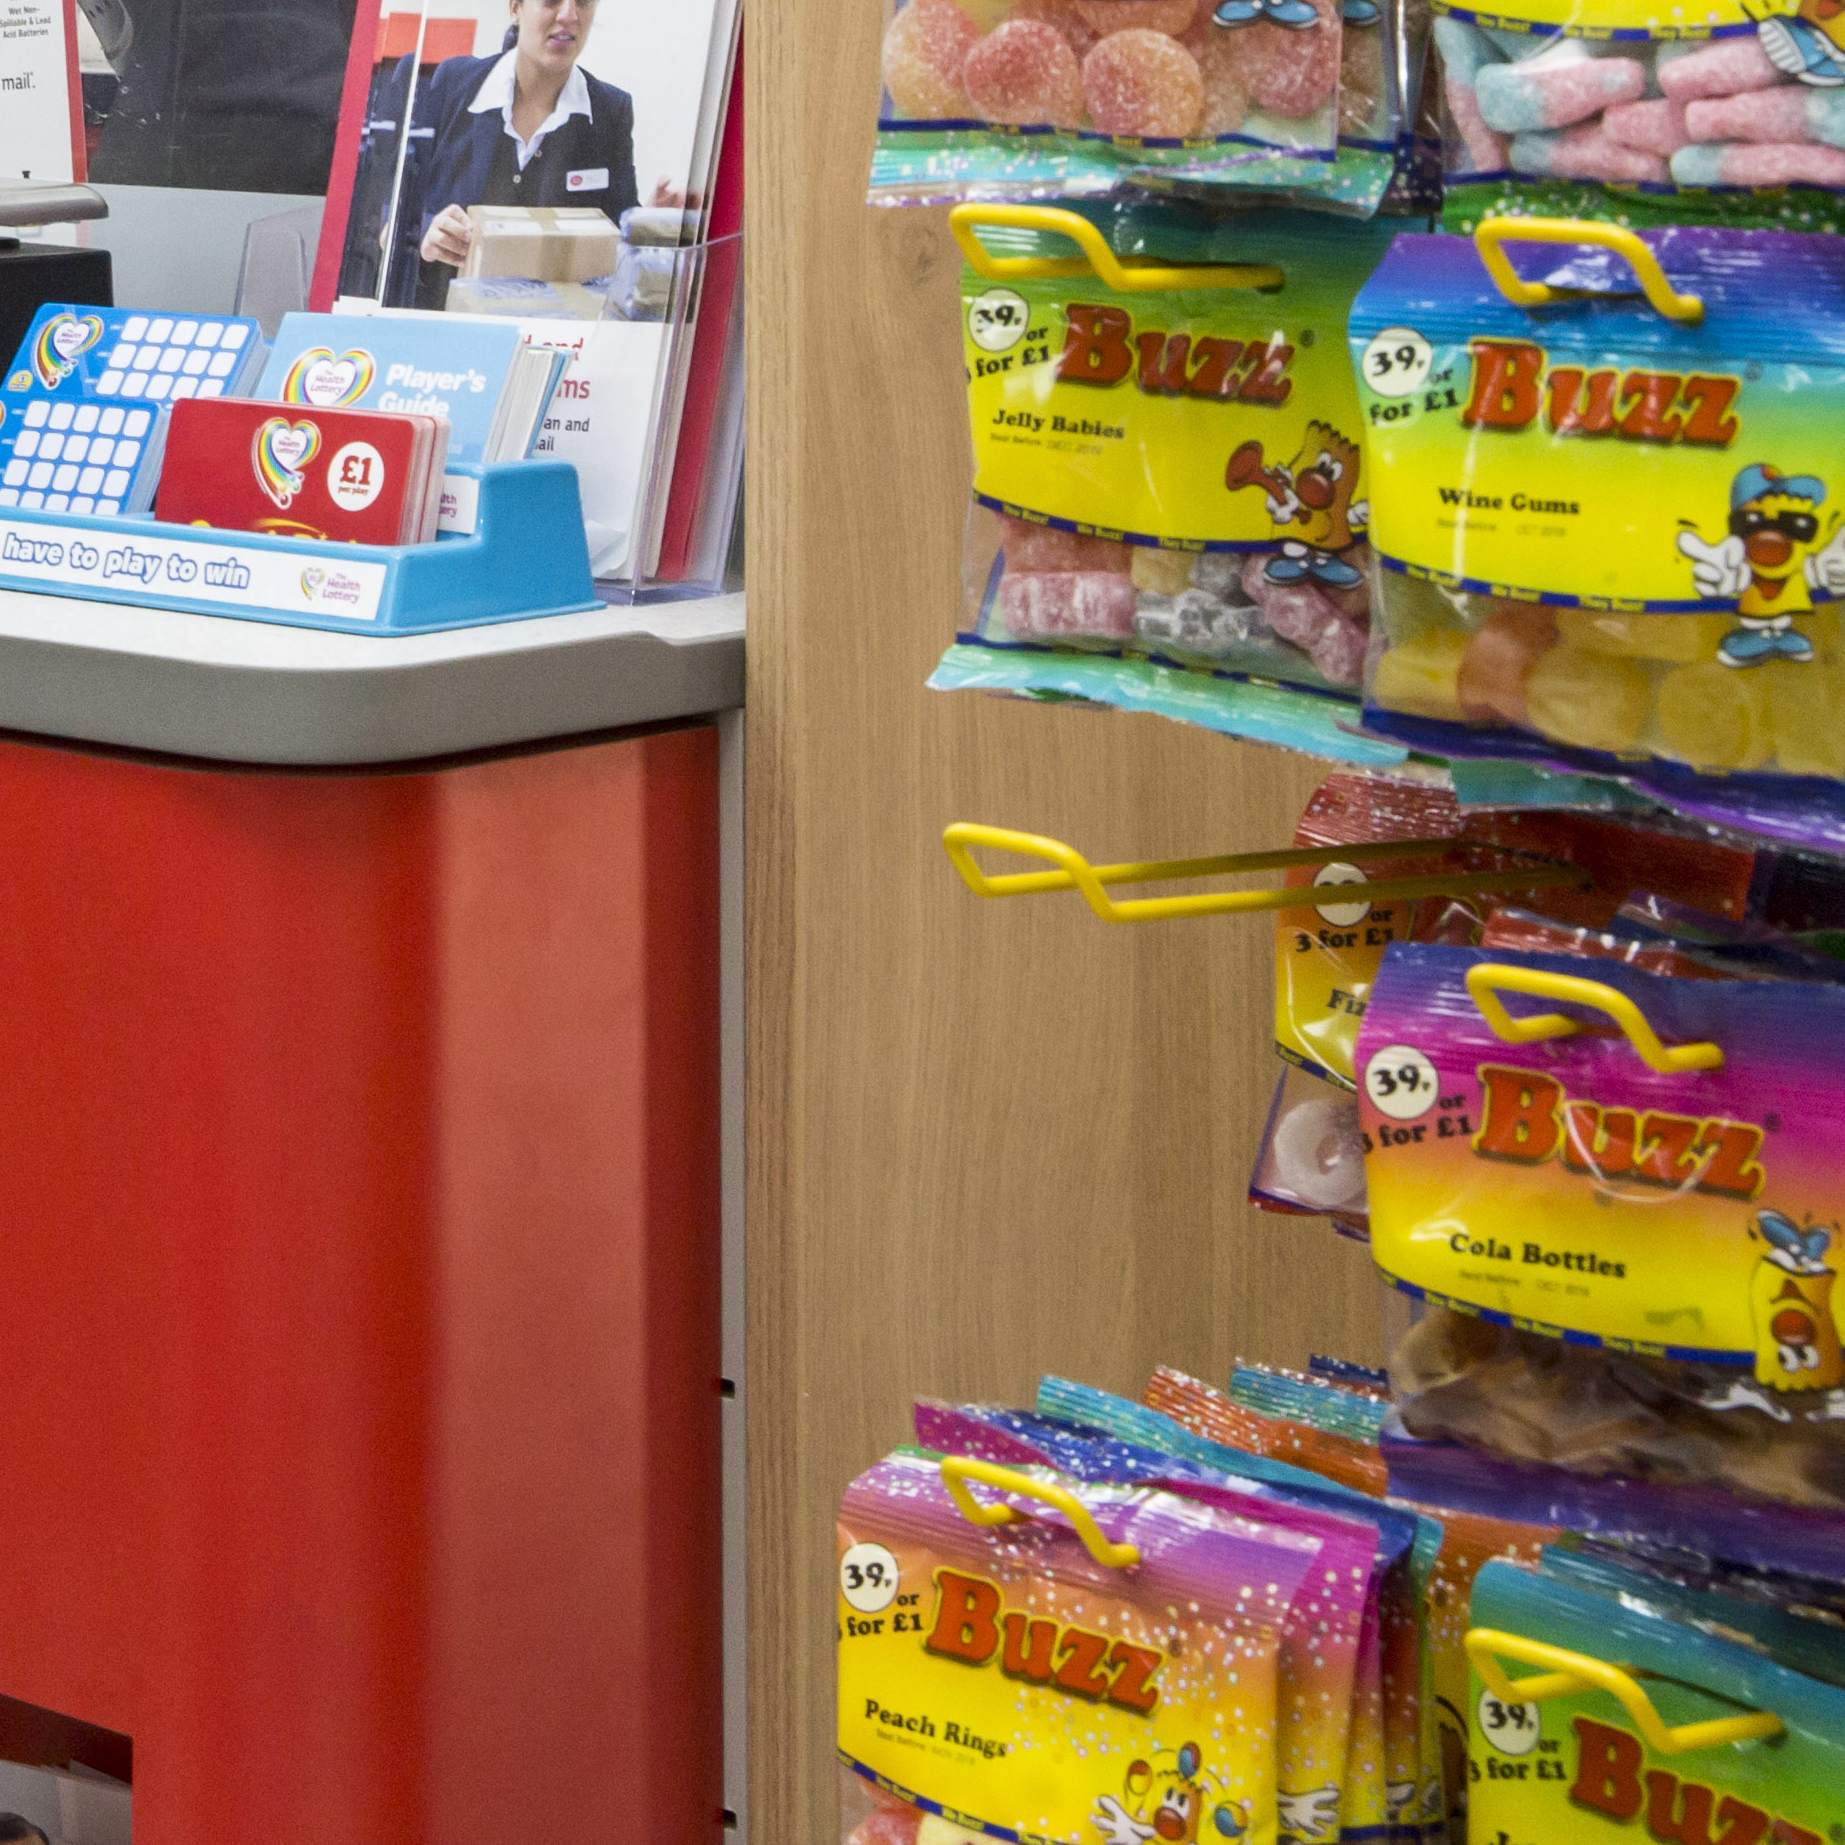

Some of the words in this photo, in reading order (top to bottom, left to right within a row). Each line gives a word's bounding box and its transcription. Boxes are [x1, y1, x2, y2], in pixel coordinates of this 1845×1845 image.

[386, 364, 487, 394] Player's
[1053, 302, 1297, 409] Buzz
[378, 395, 450, 416] Guide
[1462, 338, 1741, 448] Buzz
[991, 409, 1044, 439] Jelly
[1050, 417, 1126, 442] Babies
[339, 455, 370, 486] £1
[1437, 487, 1500, 515] Wine
[1508, 492, 1580, 518] Gums
[4, 531, 61, 566] have
[70, 544, 98, 570] to
[103, 546, 161, 583] play
[167, 555, 197, 583] to
[204, 557, 250, 589] win
[1472, 1062, 1767, 1200] Buzz
[1450, 1232, 1510, 1262] Cola
[1522, 1242, 1626, 1279] Bottles
[924, 1565, 1167, 1716] Buzz
[863, 1697, 936, 1743] Peach
[942, 1721, 1008, 1763] Rings
